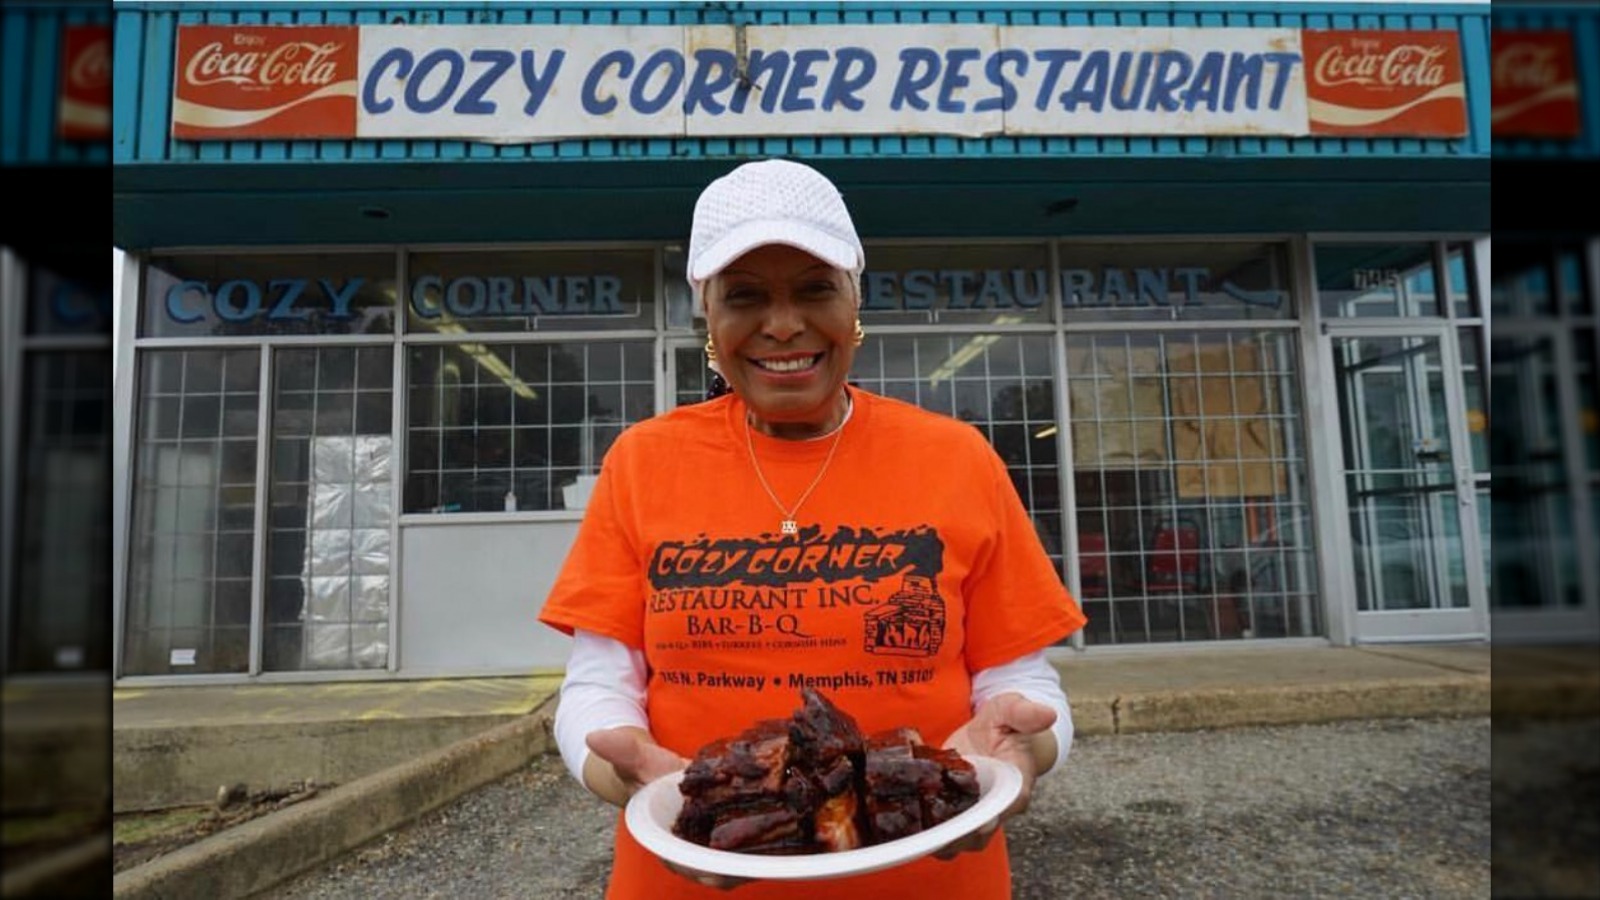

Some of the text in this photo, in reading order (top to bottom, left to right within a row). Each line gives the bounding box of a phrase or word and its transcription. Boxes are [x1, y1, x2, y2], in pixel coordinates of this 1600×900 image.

[185, 41, 346, 86] Coca-Cola
[362, 47, 1303, 116] COZY CORNER RESTAURANT
[1314, 44, 1449, 86] Coca-Cola
[165, 266, 1211, 324] COZY CORNER ESTAURANT
[657, 543, 905, 575] COZY CORNER
[650, 585, 880, 613] RESTAURANT INC.
[686, 614, 814, 639] BAR-B-Q
[697, 671, 766, 691] Parkway
[788, 671, 873, 691] Memphis,
[876, 670, 897, 685] TN
